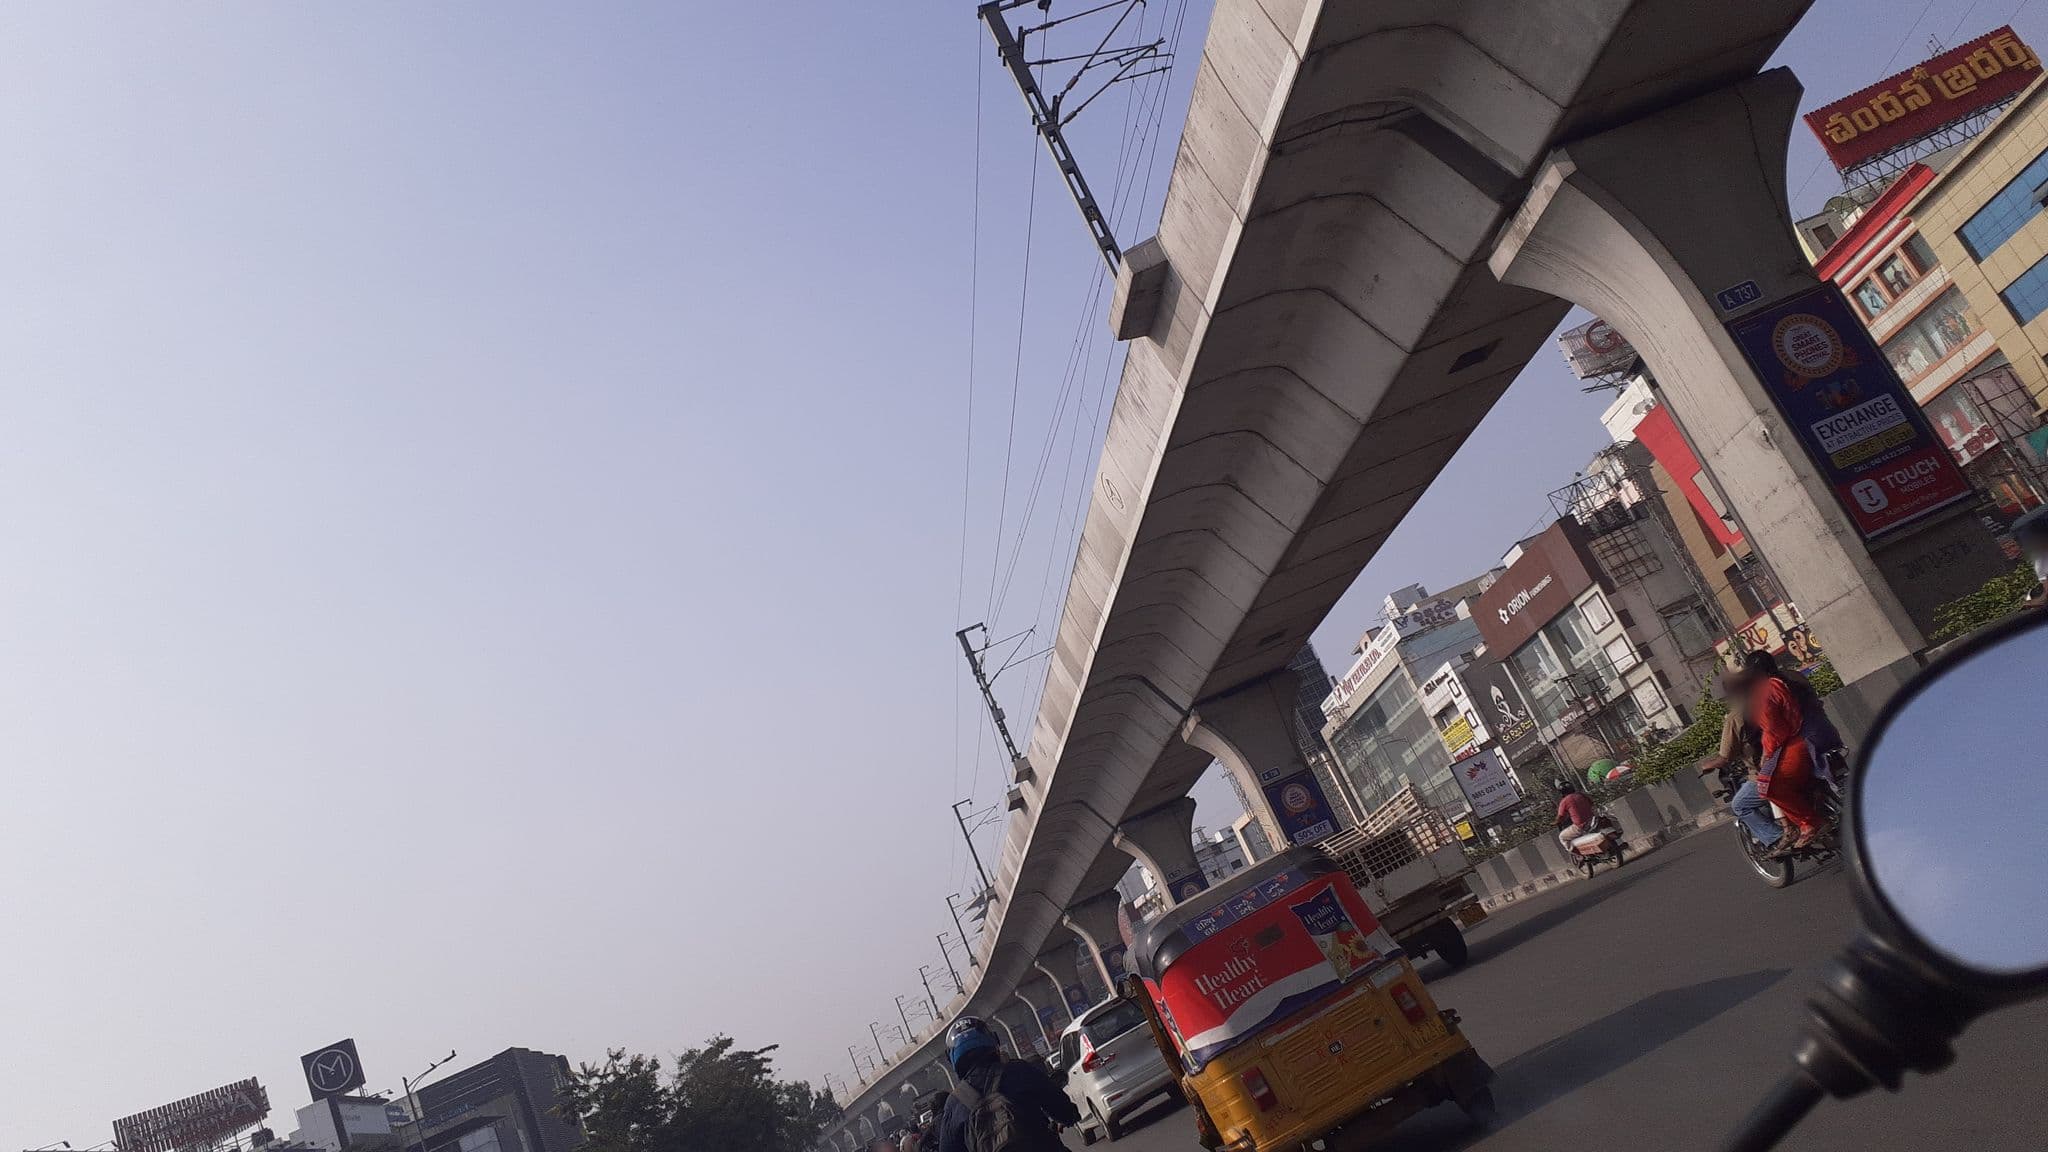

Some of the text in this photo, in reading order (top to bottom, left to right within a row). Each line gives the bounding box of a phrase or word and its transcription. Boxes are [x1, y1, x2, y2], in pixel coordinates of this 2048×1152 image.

[1791, 334, 1820, 351] SMART
[1793, 341, 1828, 359] PHONES
[1817, 399, 1896, 438] EXCHANGE
[1881, 456, 1941, 486] TOUCH
[1899, 475, 1937, 494] MOBILES
[1506, 588, 1530, 614] ORION
[1313, 821, 1326, 833] OFF
[1303, 902, 1335, 924] Healthy
[1313, 913, 1338, 929] Heart
[1194, 950, 1257, 994] Healthy
[1213, 973, 1264, 1009] Heart
